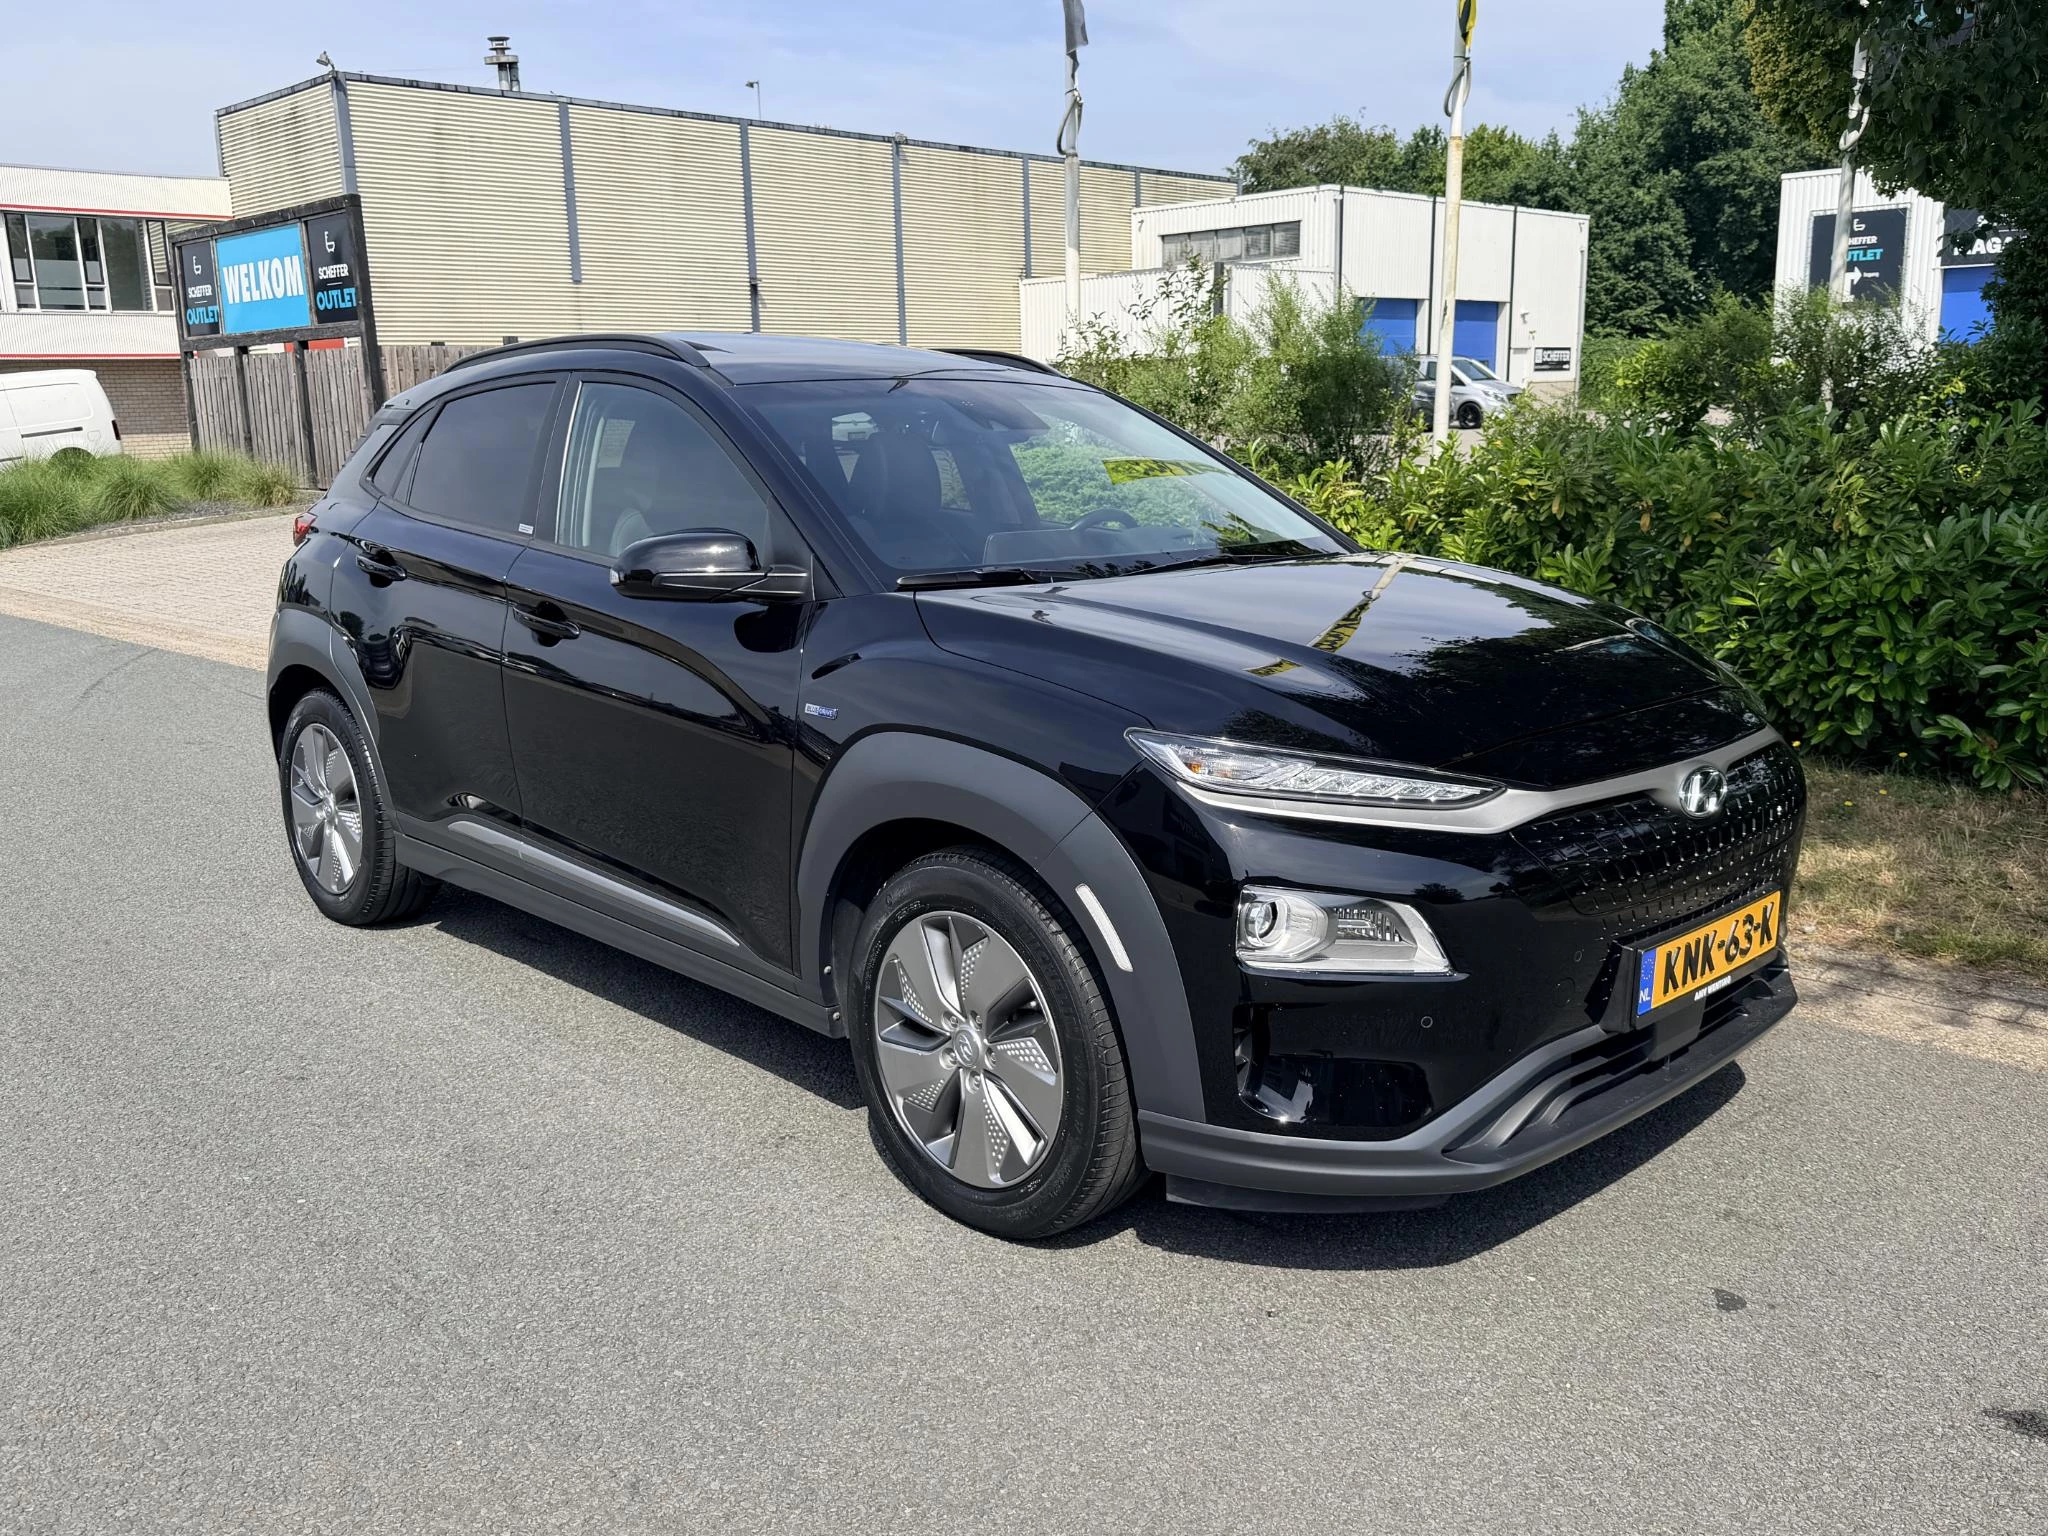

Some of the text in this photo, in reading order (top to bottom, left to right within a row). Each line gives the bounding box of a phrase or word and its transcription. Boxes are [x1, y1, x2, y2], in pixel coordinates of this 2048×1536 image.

[1848, 235, 1878, 245] HEFFER
[1846, 248, 1884, 261] UTLET
[223, 255, 304, 304] WELKOM
[318, 263, 349, 280] SCHEFFER
[188, 284, 212, 299] SCHEFFER
[316, 287, 357, 311] OUTLET
[186, 304, 219, 325] OUTLET
[1663, 902, 1775, 997] KNK-63-K
[1639, 989, 1651, 1003] NL
